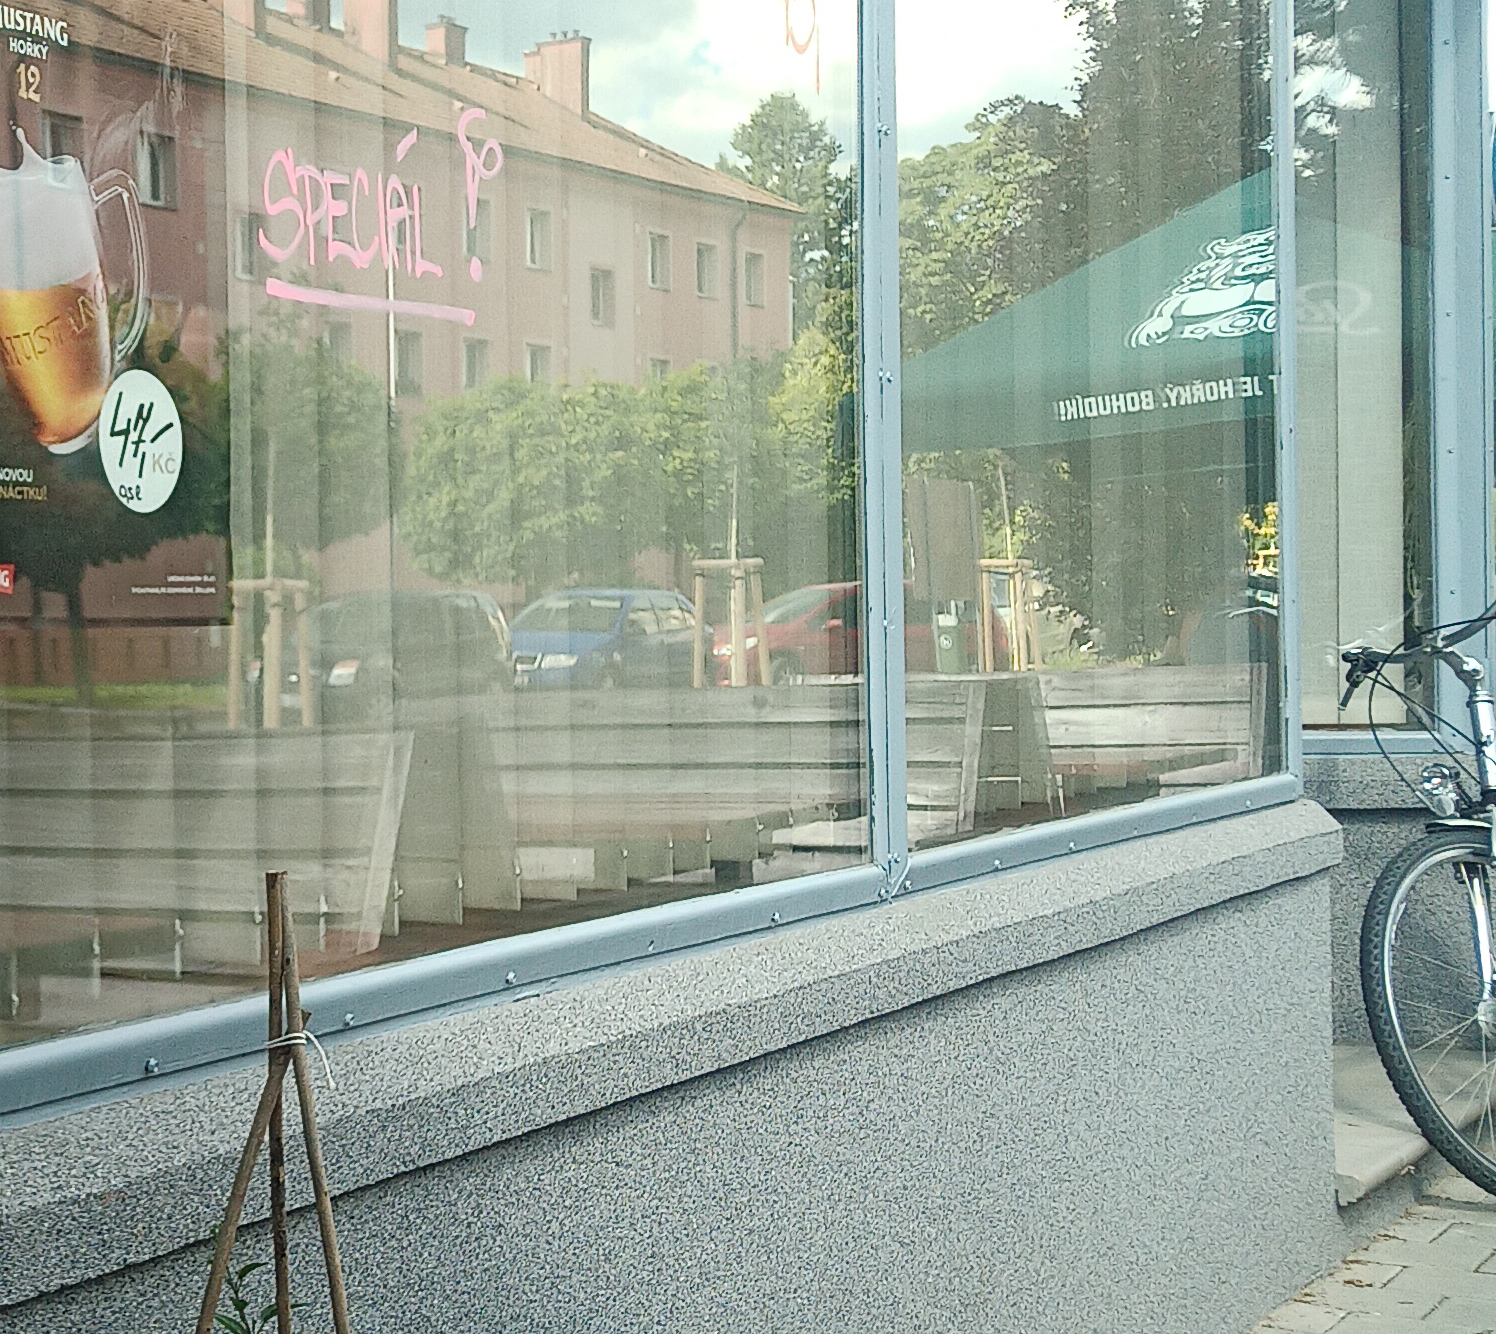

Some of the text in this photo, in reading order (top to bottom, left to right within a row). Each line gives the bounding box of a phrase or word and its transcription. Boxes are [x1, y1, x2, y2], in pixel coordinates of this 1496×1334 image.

[8, 36, 50, 61] HOŘKÝ
[16, 62, 42, 103] 12
[151, 452, 177, 475] Kč
